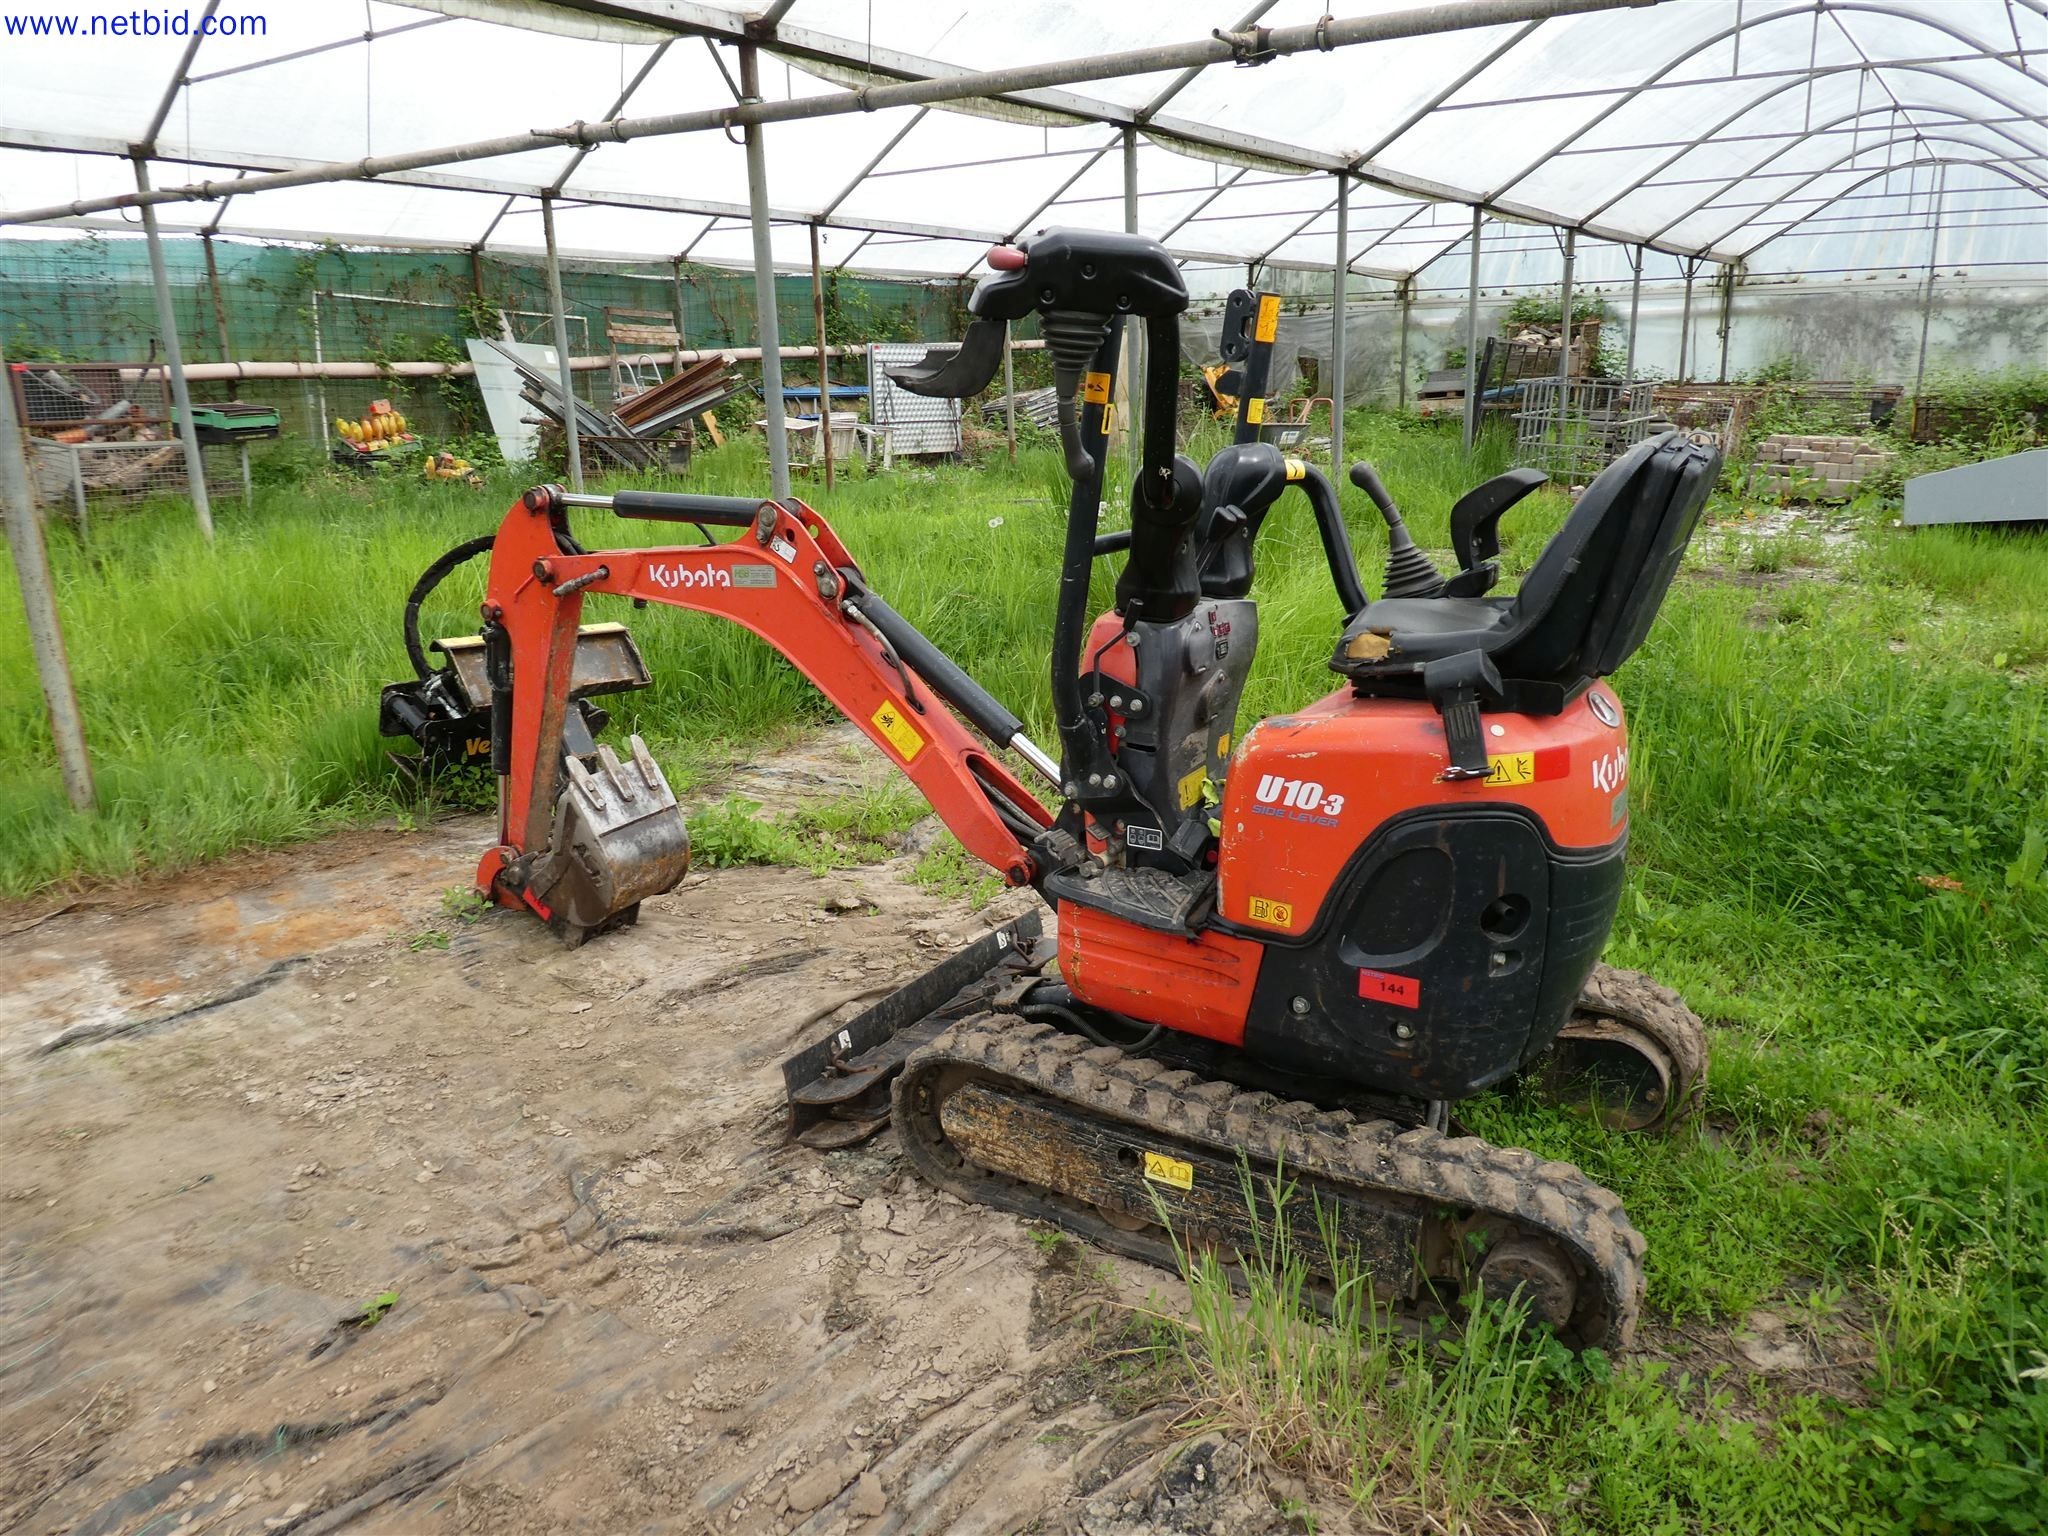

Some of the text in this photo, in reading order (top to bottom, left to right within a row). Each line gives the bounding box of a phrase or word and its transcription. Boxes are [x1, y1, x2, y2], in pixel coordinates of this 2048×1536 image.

[649, 563, 731, 588] Kubota
[1255, 774, 1345, 816] U10-3
[1252, 804, 1339, 828] SIDE LEVER
[1380, 981, 1406, 996] 144
